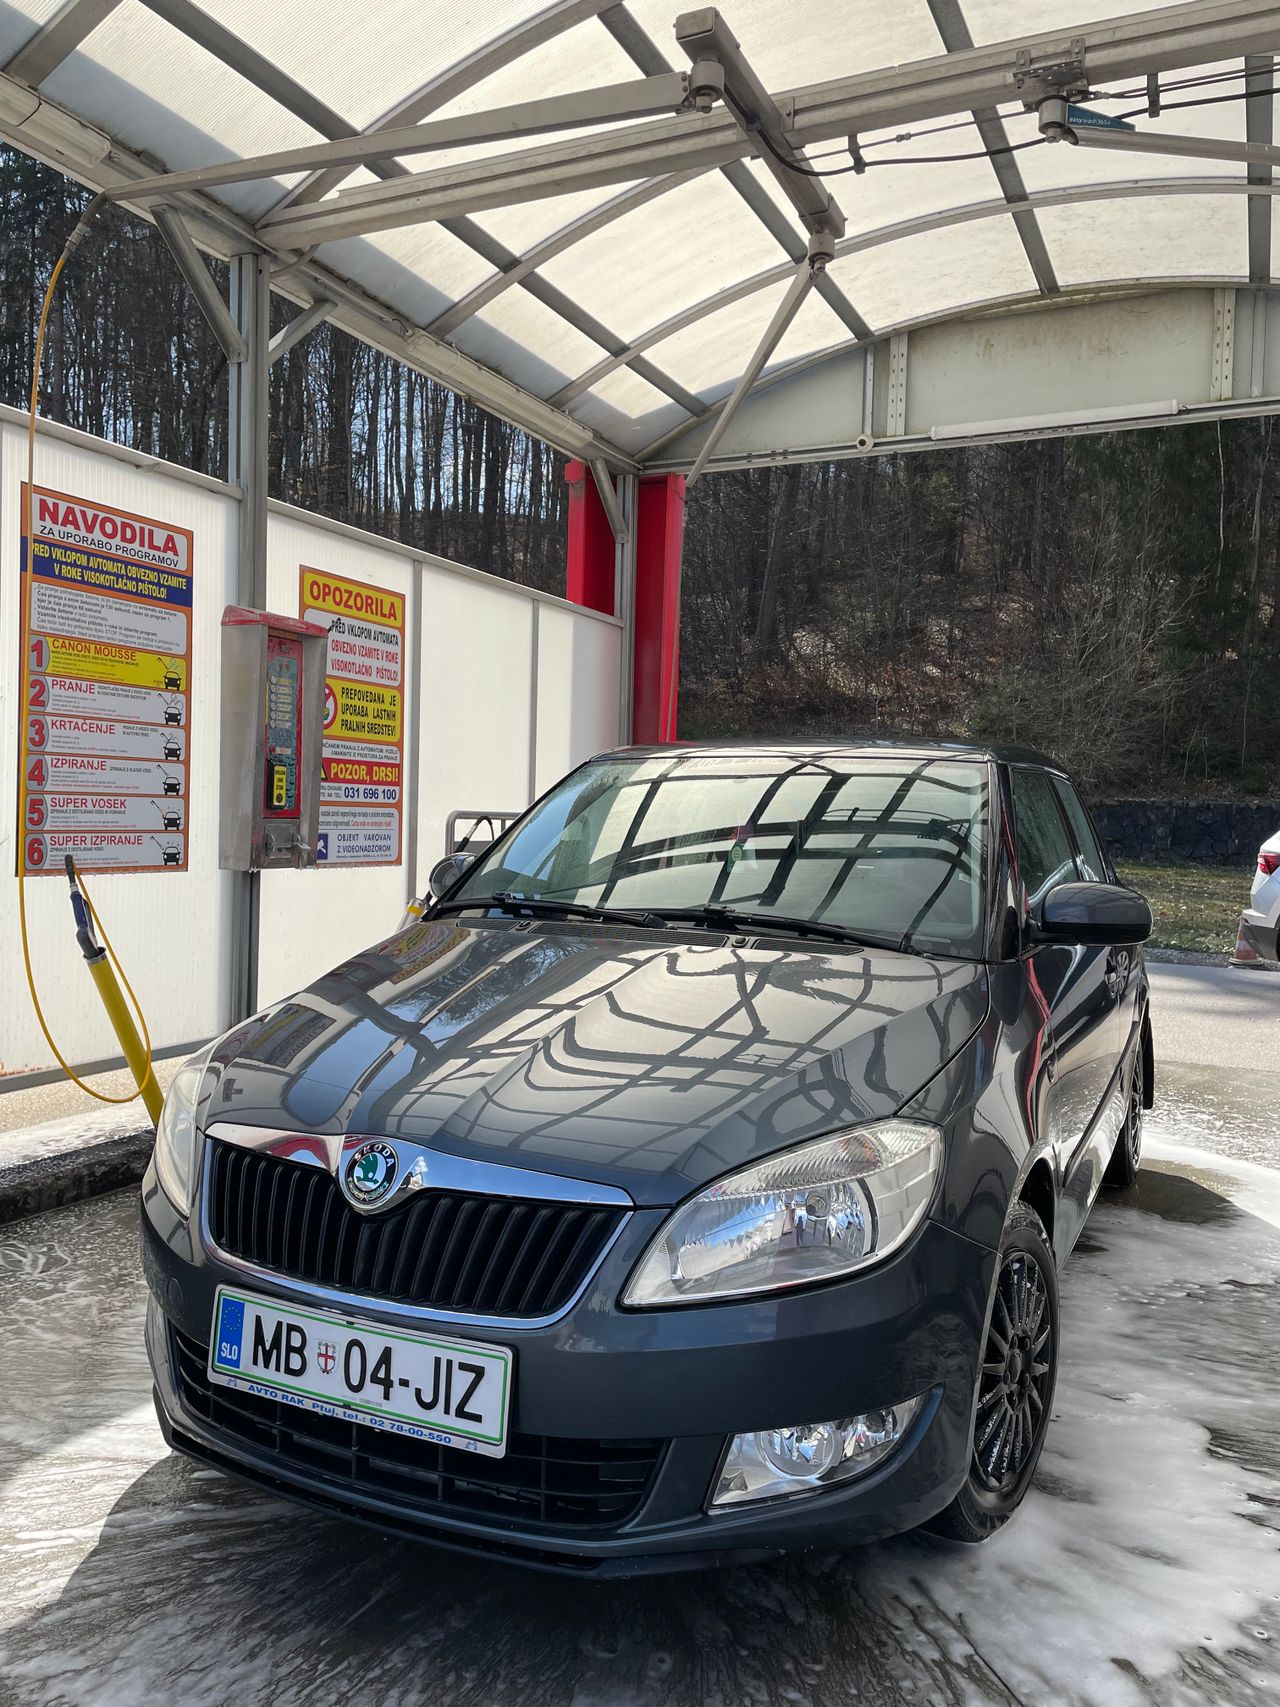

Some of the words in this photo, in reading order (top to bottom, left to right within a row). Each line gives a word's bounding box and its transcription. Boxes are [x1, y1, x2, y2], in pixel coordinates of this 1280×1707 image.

[39, 498, 179, 557] NAVODILA
[40, 525, 55, 537] ZA
[58, 529, 112, 551] UPORABO
[115, 544, 179, 568] PROGRAMOV
[51, 547, 87, 566] VKLOPOM
[89, 556, 126, 575] AVTOMATA
[127, 566, 158, 583] OBVEZNO
[160, 572, 187, 589] VZAMITE
[53, 563, 60, 575] V
[61, 565, 82, 580] ROKE
[83, 569, 137, 592] VISOKOTLAČNO
[137, 582, 167, 599] PIŠTOLO!
[309, 580, 397, 621] OPOZORILA
[331, 619, 345, 634] PRED
[347, 623, 372, 641] VKLOPOM
[373, 630, 399, 646] AVTOMATA
[31, 640, 43, 668] 1
[52, 639, 91, 655] CANON
[94, 645, 136, 662] MOUSSE
[331, 639, 357, 656] OBVEZNO
[357, 644, 380, 660] VZAMITE
[380, 650, 385, 662] V
[385, 650, 399, 664] ROKE
[331, 658, 372, 677] VISOKOTLAČNO
[375, 665, 398, 682] PIŠTOLO!
[29, 679, 46, 707] 2
[51, 679, 96, 695] PRANJE
[341, 686, 385, 706] PREPOVEDANA
[389, 695, 396, 706] JE
[341, 702, 368, 718] UPORABA
[373, 709, 396, 721] LASTNIH
[29, 718, 45, 747] 3
[51, 719, 116, 735] KRTAČENJE
[340, 719, 366, 734] PRALNIH
[367, 722, 396, 737] SREDSTEV!
[27, 758, 46, 786] 4
[50, 758, 107, 771] IZPIRANJE
[330, 762, 370, 784] POZOR,
[372, 766, 399, 782] DRSI!
[50, 797, 88, 809] SUPER
[91, 799, 127, 809] VOSEK
[344, 786, 360, 798] 031
[363, 788, 379, 799] 696
[381, 788, 397, 800] 100
[28, 798, 45, 827] 5
[50, 835, 87, 847] SUPER
[90, 835, 143, 846] IZPIRANJE
[337, 833, 359, 841] OBJEKT
[363, 833, 391, 841] VAROVAN
[337, 845, 341, 853] Z
[342, 844, 391, 853] VIDEONADZOROM
[27, 837, 43, 865] 6
[220, 1342, 239, 1361] SLO
[252, 1314, 307, 1378] MB
[343, 1338, 486, 1424] 04-JIZ
[248, 1384, 278, 1398] AVTO
[281, 1393, 305, 1406] RAK
[343, 1410, 366, 1423] tel.:
[369, 1417, 385, 1428] 02
[388, 1422, 452, 1444] 78-00-550
